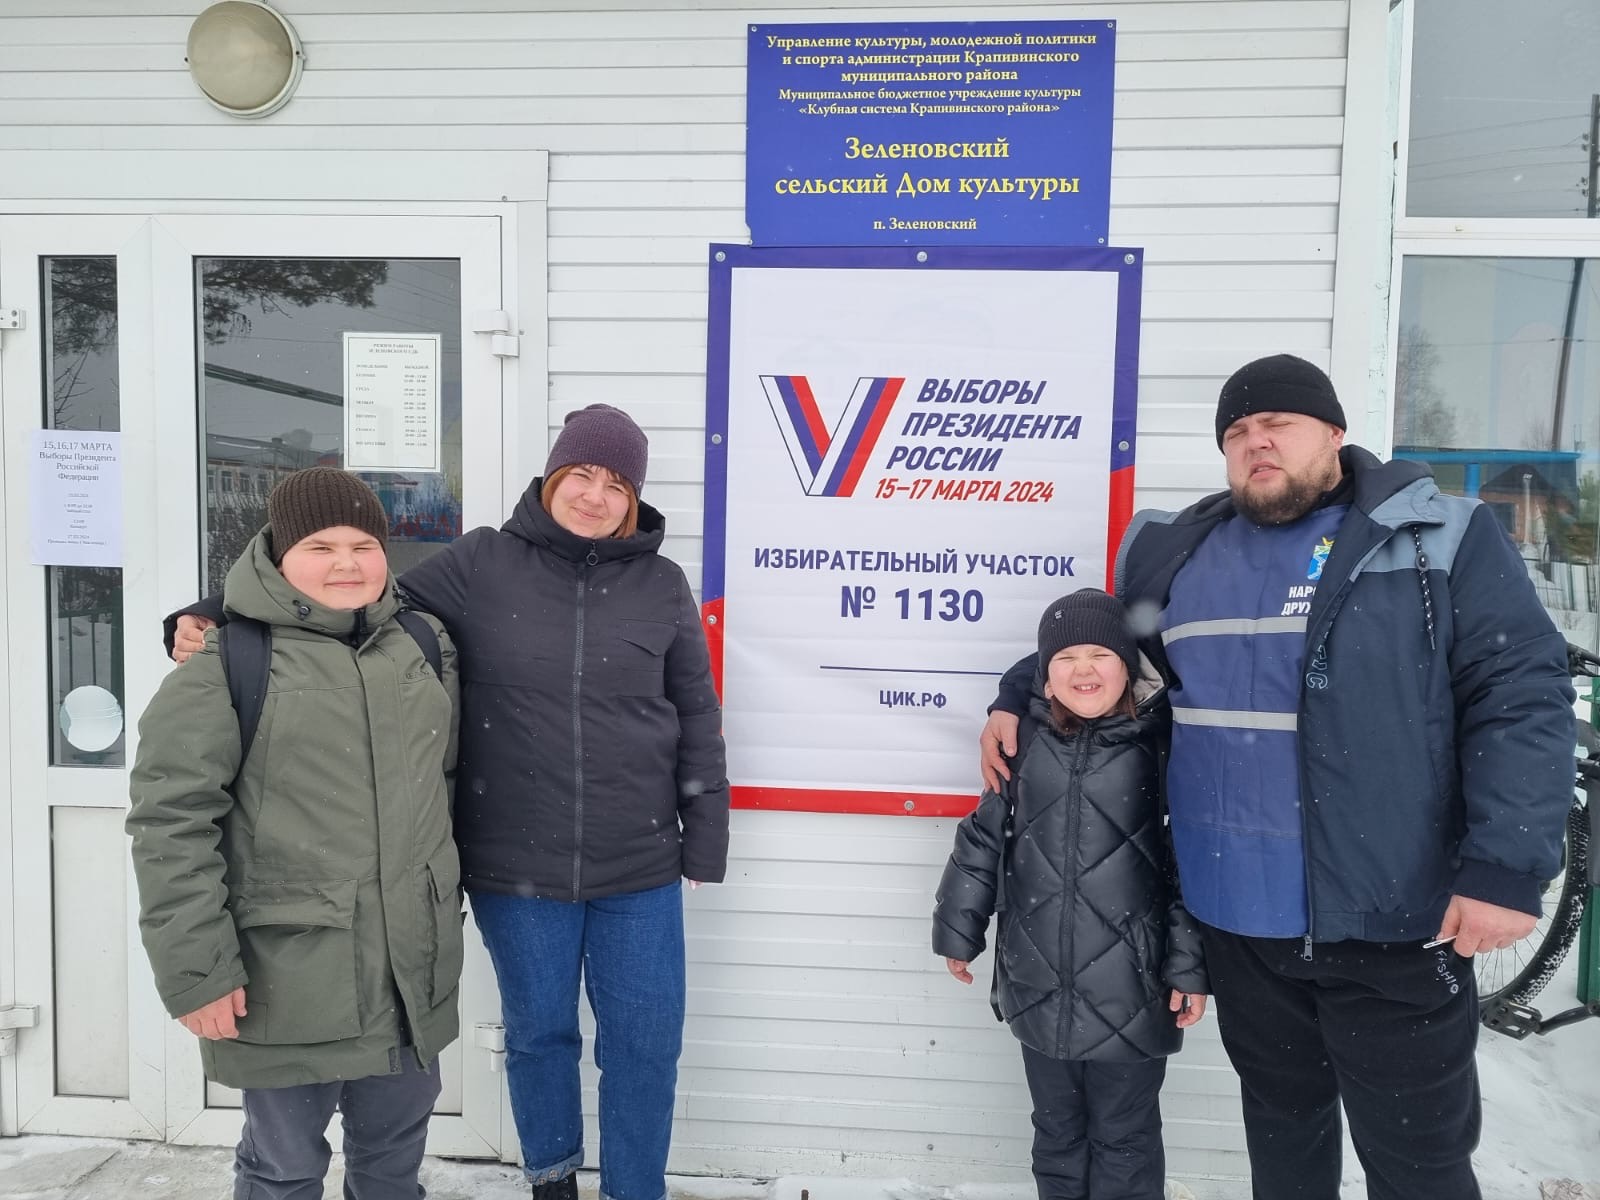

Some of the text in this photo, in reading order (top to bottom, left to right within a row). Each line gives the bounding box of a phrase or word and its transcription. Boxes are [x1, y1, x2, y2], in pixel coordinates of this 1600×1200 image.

[767, 33, 1097, 51] Управление культуры, молодежной политики
[782, 50, 1080, 68] и спорта администрации Крапивинского
[840, 68, 1018, 85] муниципального района
[779, 87, 1081, 103] Муниципальное бюджетное учреждение культуры
[798, 102, 1060, 118] «Клубная система Крапивинского района»
[844, 136, 1010, 159] Зеленовский
[775, 172, 1080, 201] сельский Дом культуры
[873, 217, 977, 230] п. Зеленовский
[917, 379, 1047, 404] ВЫБОРЫ
[901, 413, 1082, 442] ПРЕЗИДЕНТА
[80, 442, 113, 451] МАРТА
[39, 451, 117, 463] Выборы Президента
[886, 446, 1003, 471] РОССИИ
[55, 462, 100, 471] Российской
[57, 472, 99, 483] Федерации
[931, 480, 1005, 501] МАРТА
[1003, 481, 1053, 502] 2024
[755, 548, 1074, 576] ИЗБИРАТЕЛЬНЫЙ УЧАСТОК
[841, 586, 983, 622] № 1130
[880, 690, 946, 708] ЦИК.РФ
